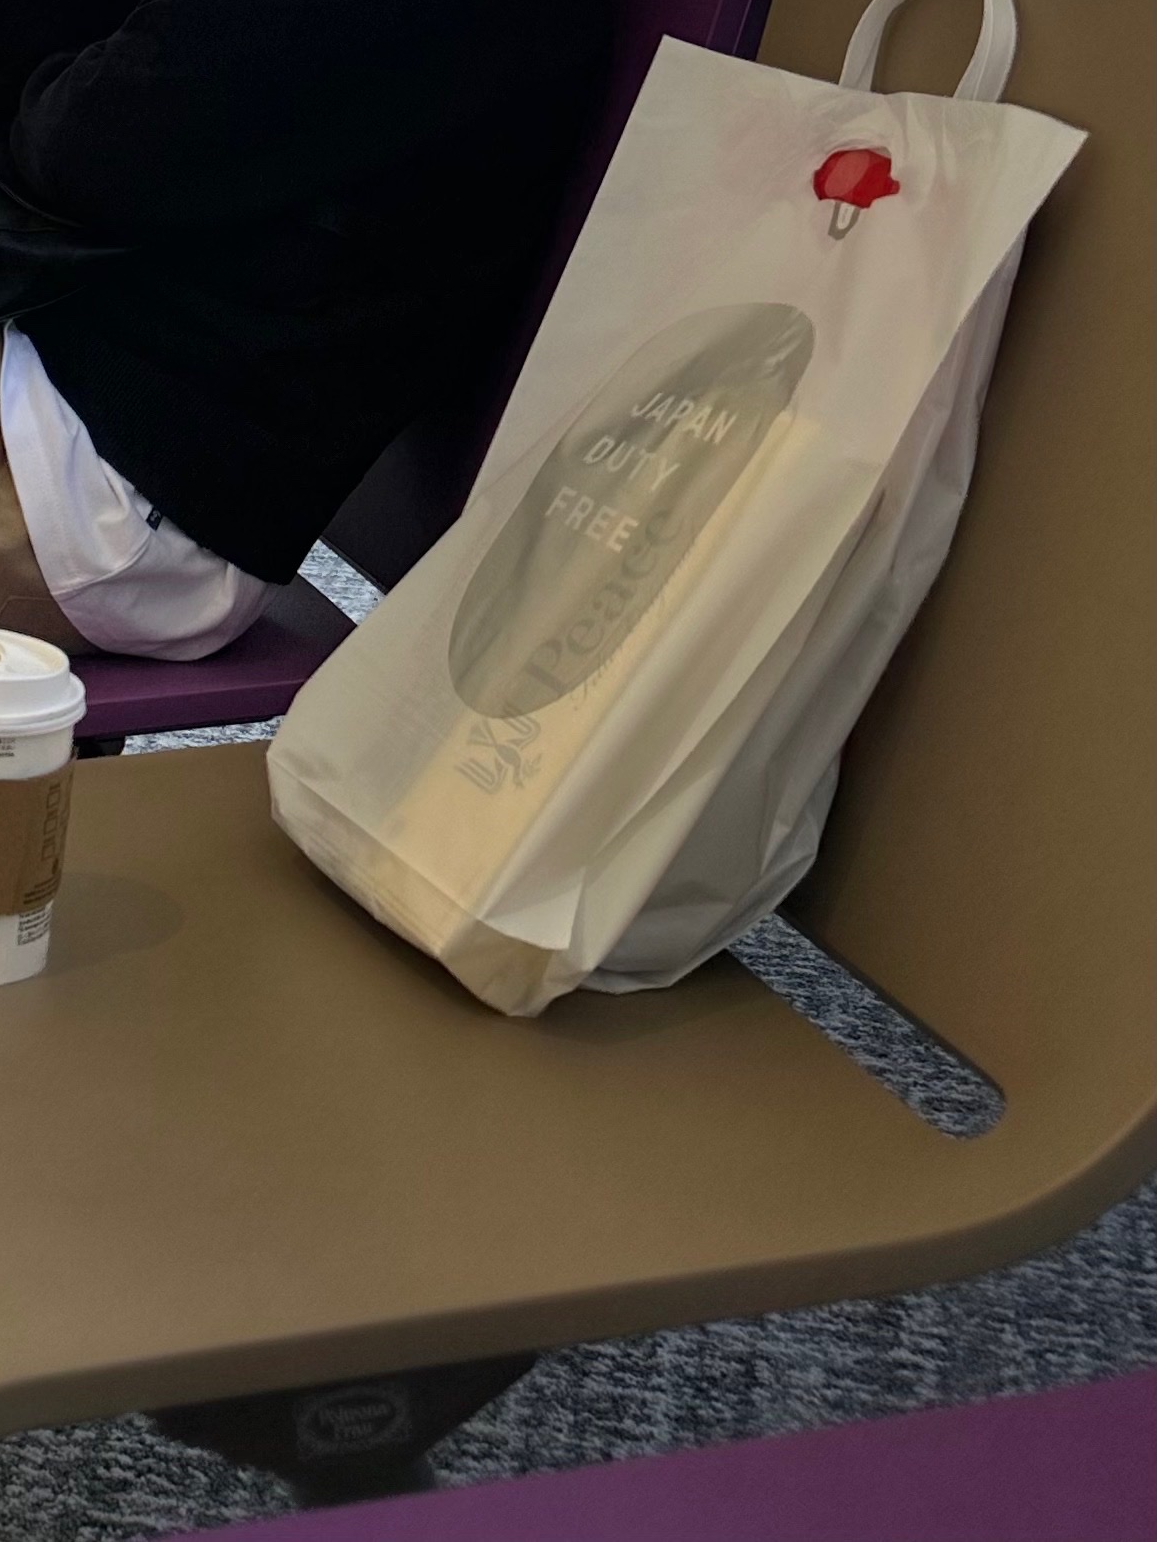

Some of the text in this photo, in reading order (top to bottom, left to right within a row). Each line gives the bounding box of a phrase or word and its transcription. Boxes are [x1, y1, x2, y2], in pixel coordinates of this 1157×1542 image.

[632, 392, 737, 445] JAPAN
[584, 435, 680, 491] DUTY
[545, 486, 639, 553] FREE
